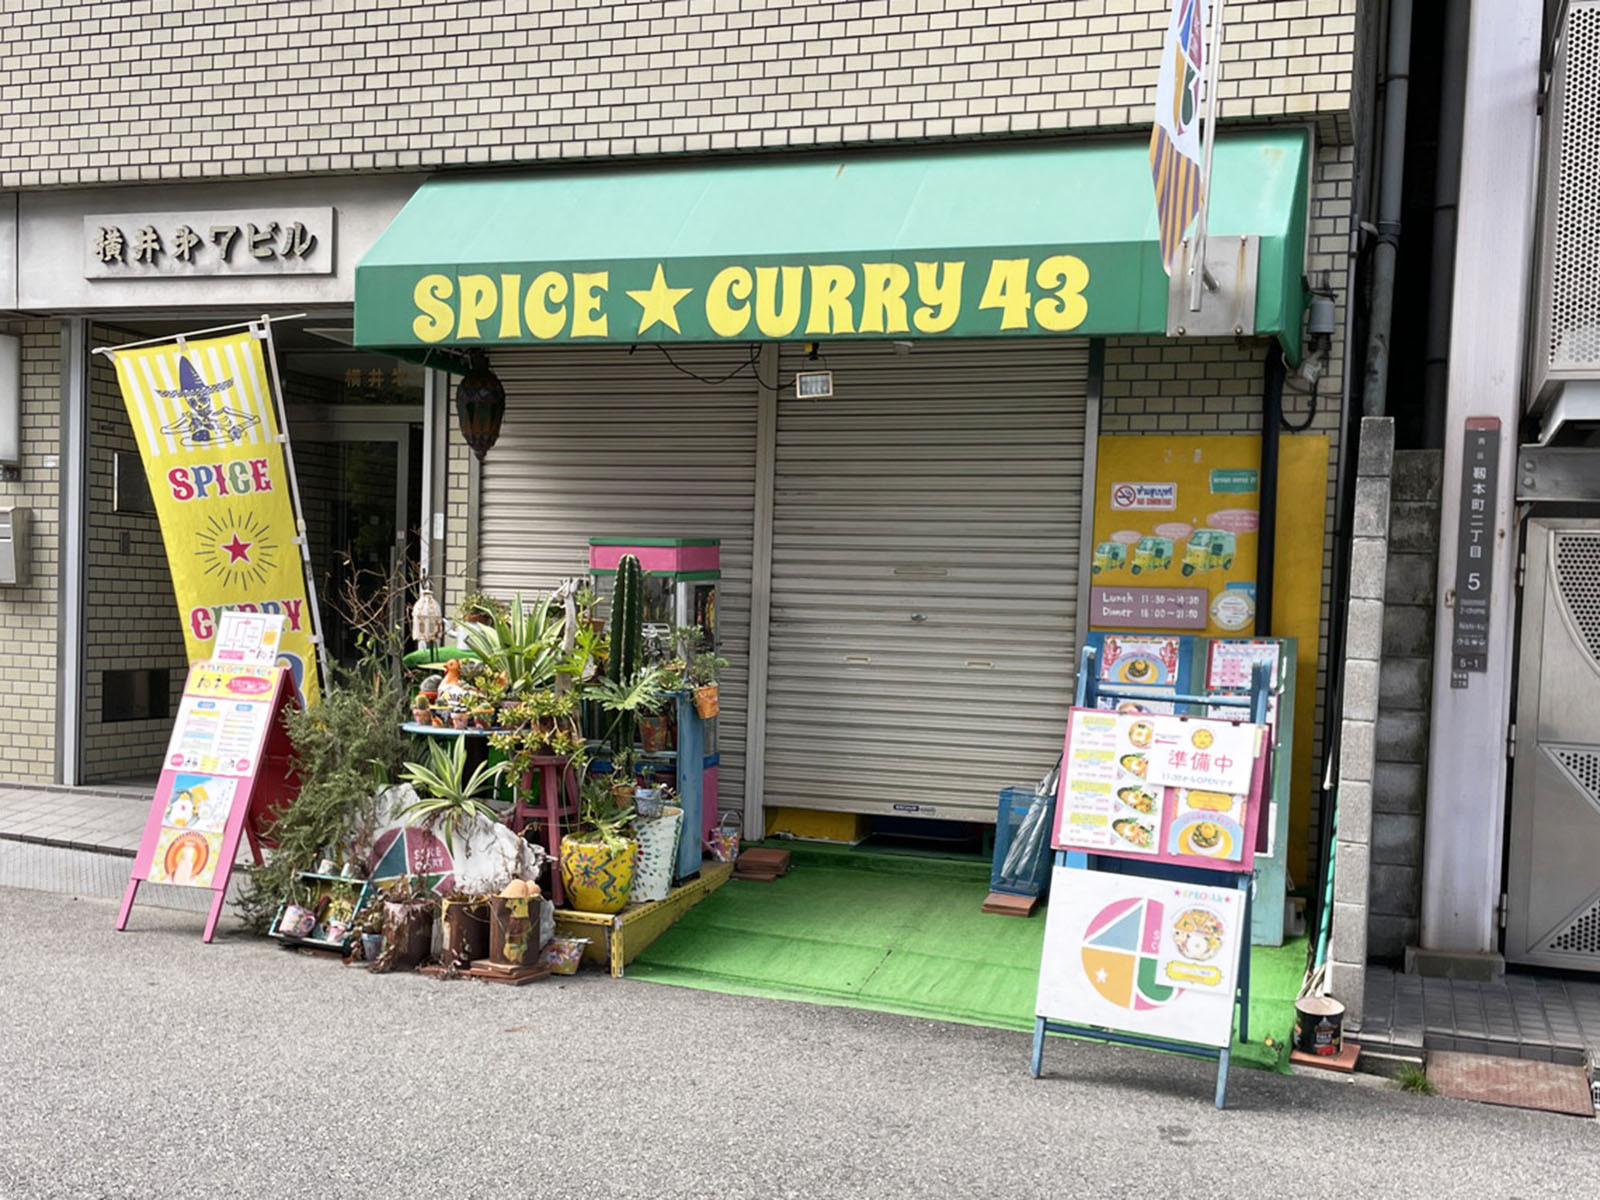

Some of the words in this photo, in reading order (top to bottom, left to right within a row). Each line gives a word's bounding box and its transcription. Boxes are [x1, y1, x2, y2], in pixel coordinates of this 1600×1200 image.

[412, 270, 609, 343] SPICE
[705, 261, 965, 338] CURRY
[978, 255, 1090, 332] 43
[168, 458, 273, 501] SPICE
[1467, 572, 1481, 591] 5
[1102, 592, 1134, 603] Lunch
[1102, 606, 1133, 617] Dinner
[1168, 749, 1233, 774] 準備中
